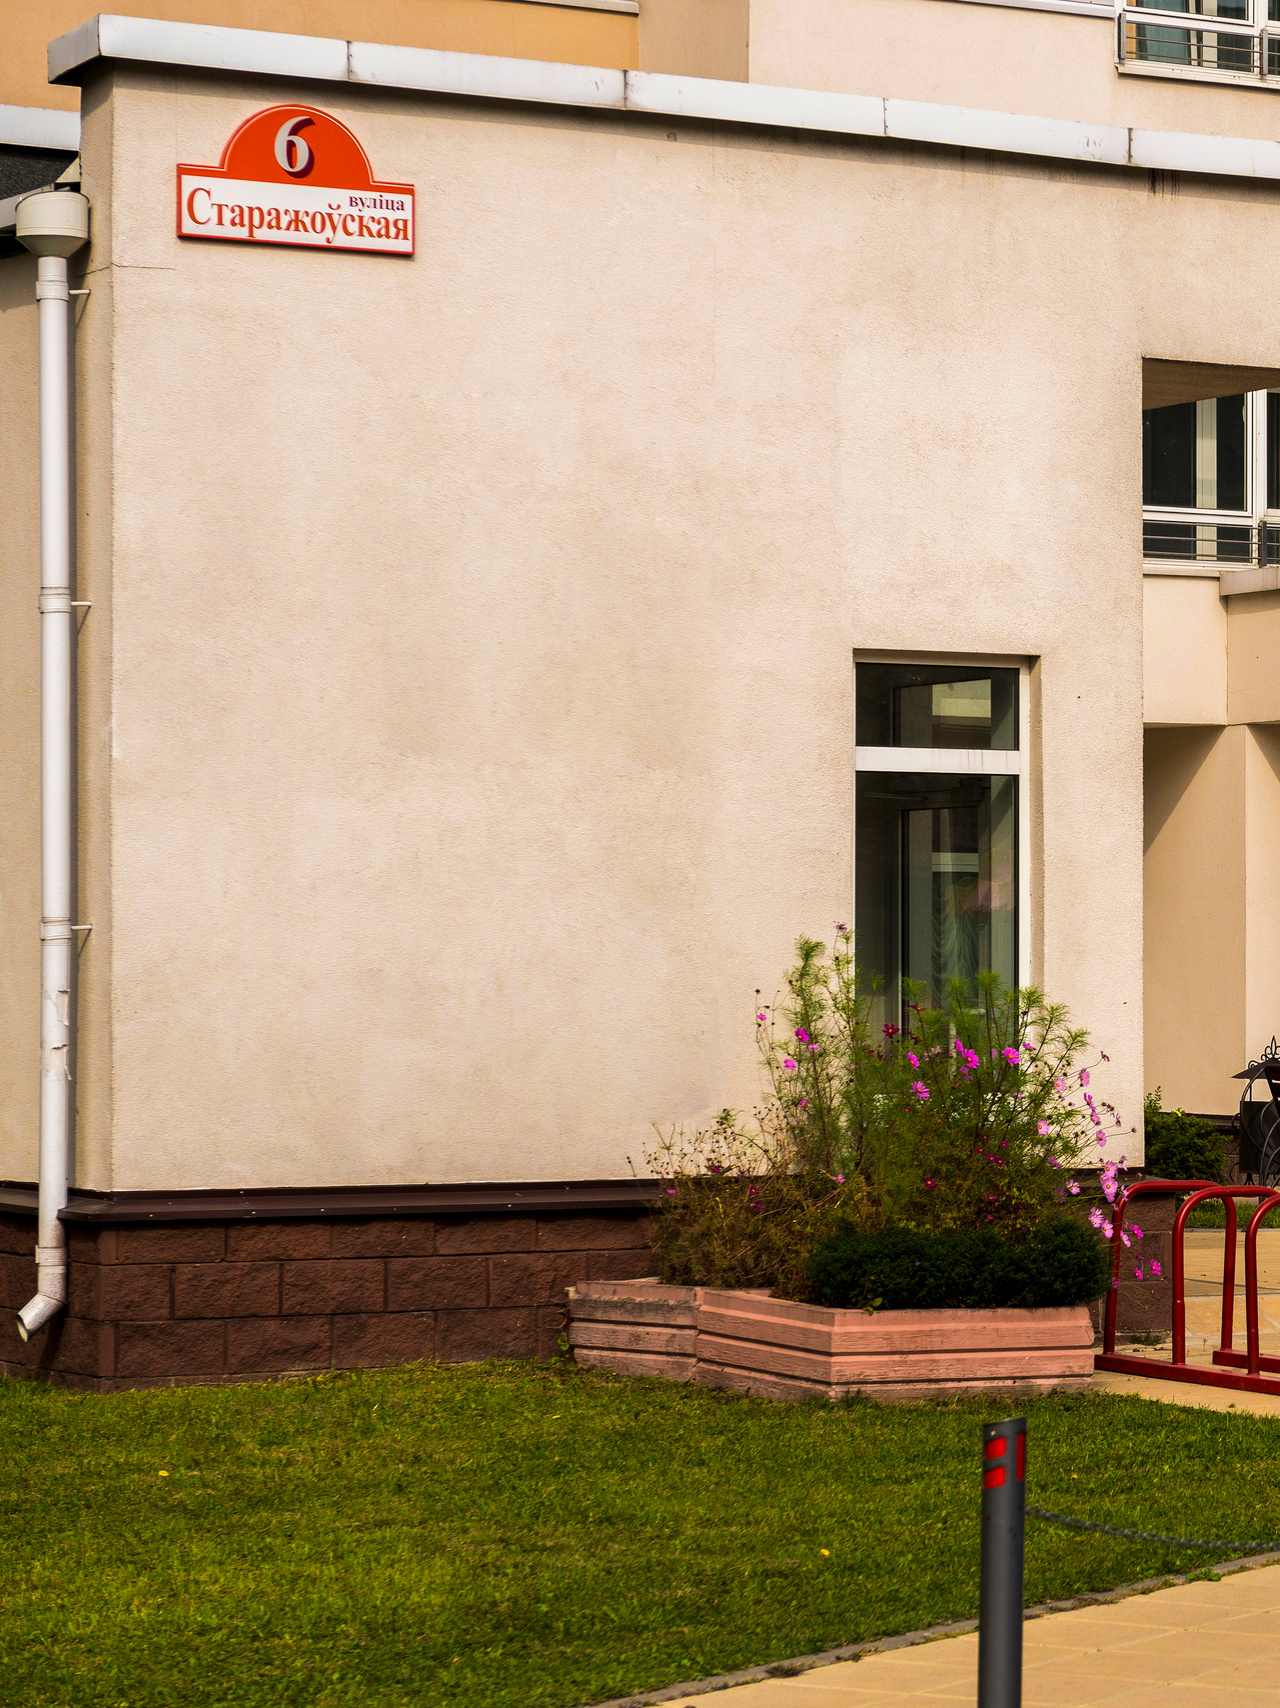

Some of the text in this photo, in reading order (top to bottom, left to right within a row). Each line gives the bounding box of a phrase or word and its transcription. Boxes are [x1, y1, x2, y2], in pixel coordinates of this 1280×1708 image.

[274, 116, 315, 178] 6
[187, 187, 410, 244] Старажоўская
[349, 195, 405, 212] вуліца
